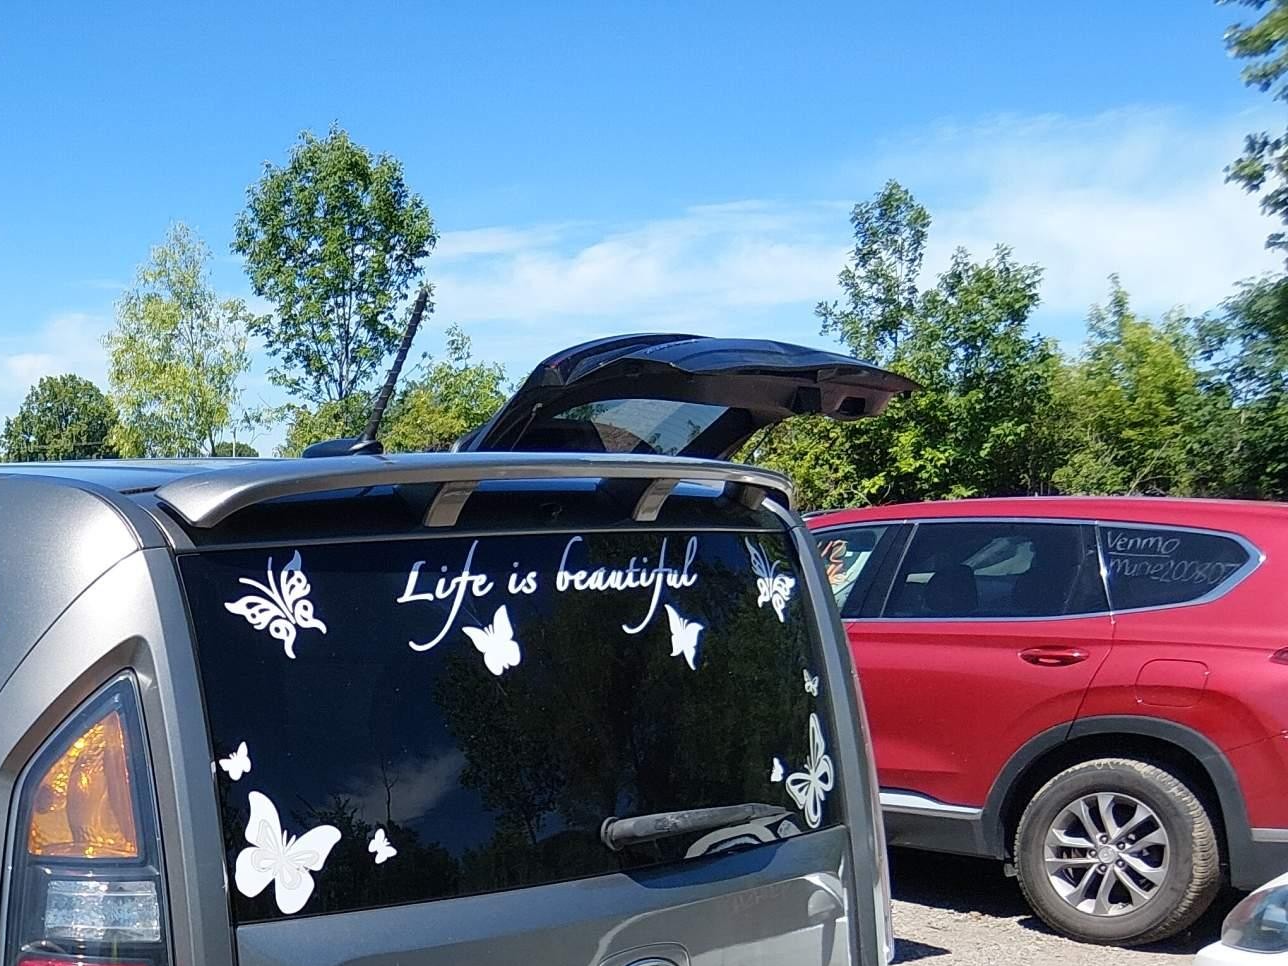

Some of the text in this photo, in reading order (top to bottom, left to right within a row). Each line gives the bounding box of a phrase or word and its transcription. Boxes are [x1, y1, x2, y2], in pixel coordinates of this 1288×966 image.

[397, 536, 698, 651] Life is beautiful
